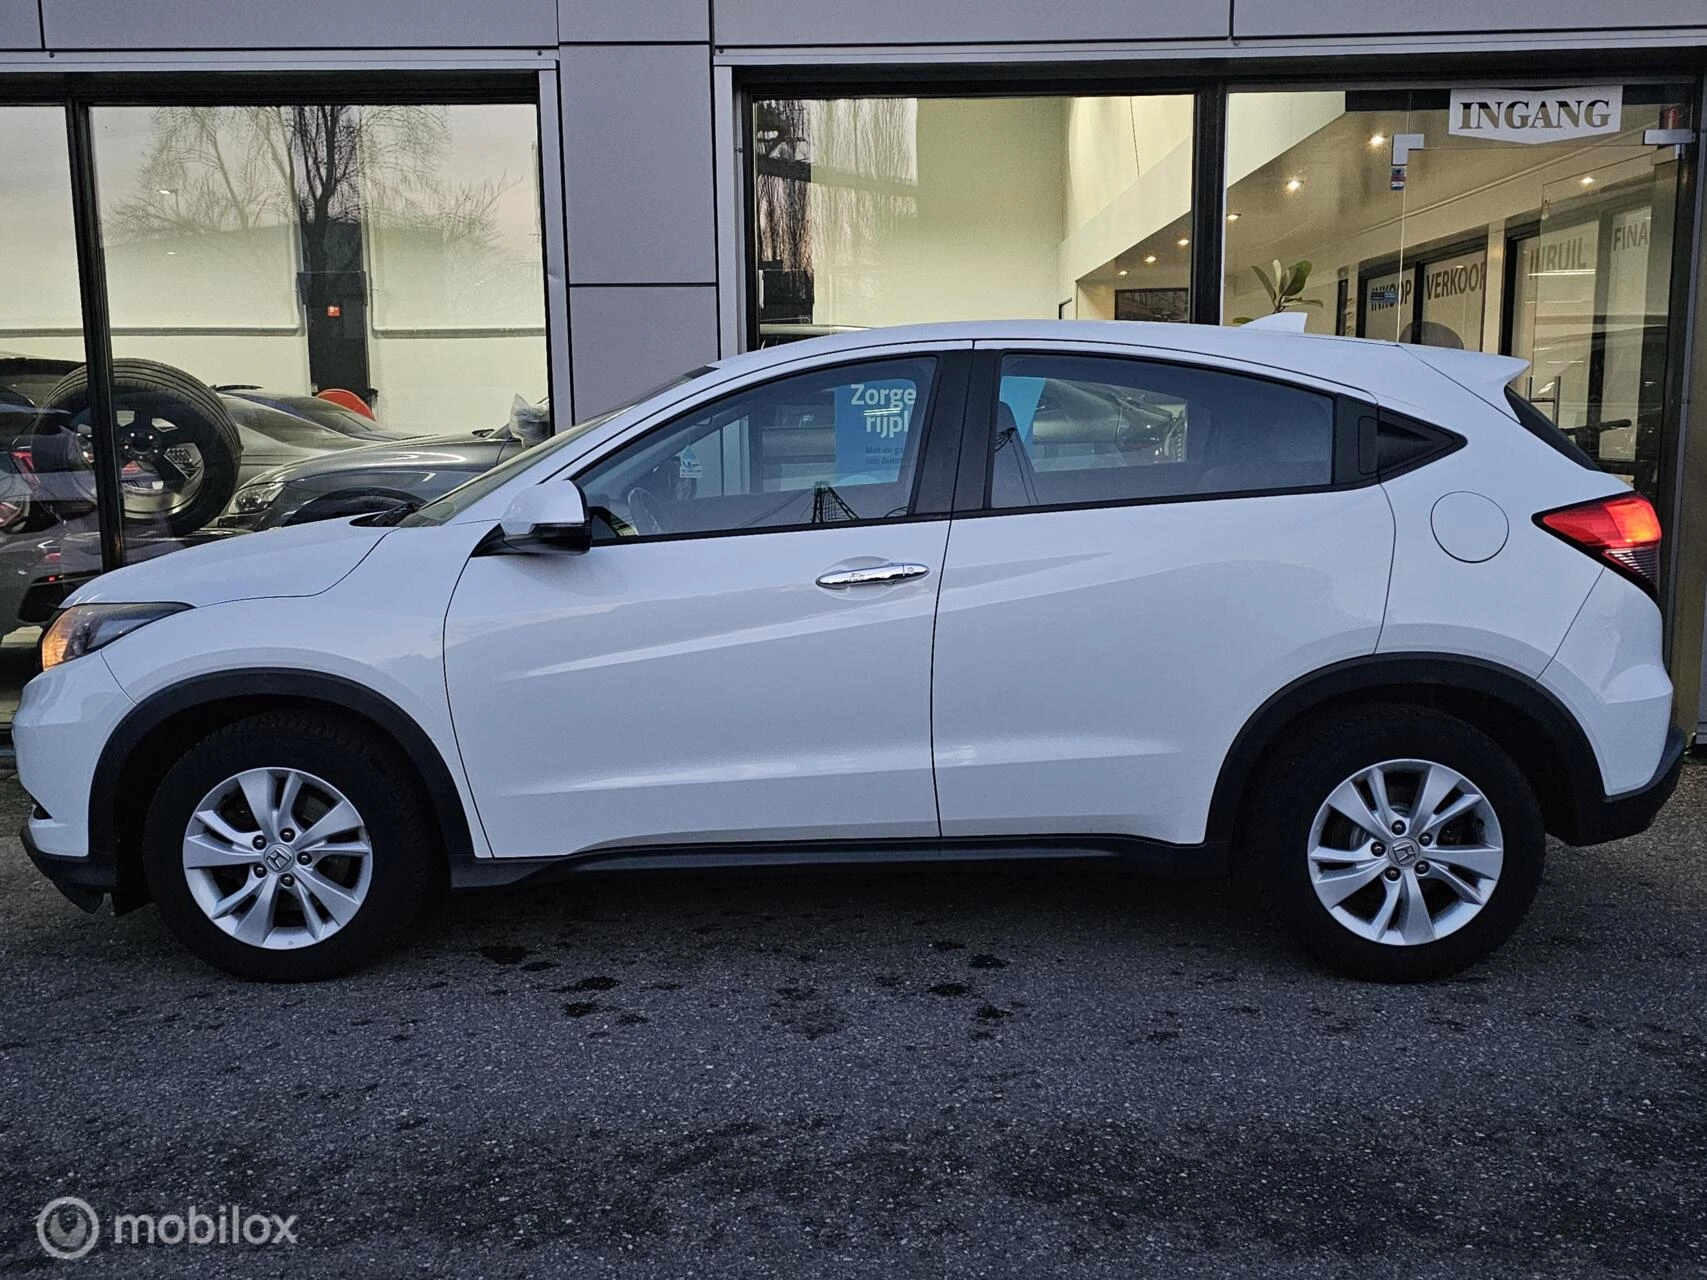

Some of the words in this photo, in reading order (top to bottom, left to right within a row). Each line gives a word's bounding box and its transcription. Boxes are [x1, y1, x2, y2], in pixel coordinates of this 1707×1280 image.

[1458, 99, 1611, 130] INGANG
[850, 384, 917, 409] Zorge
[866, 410, 909, 438] rijpl
